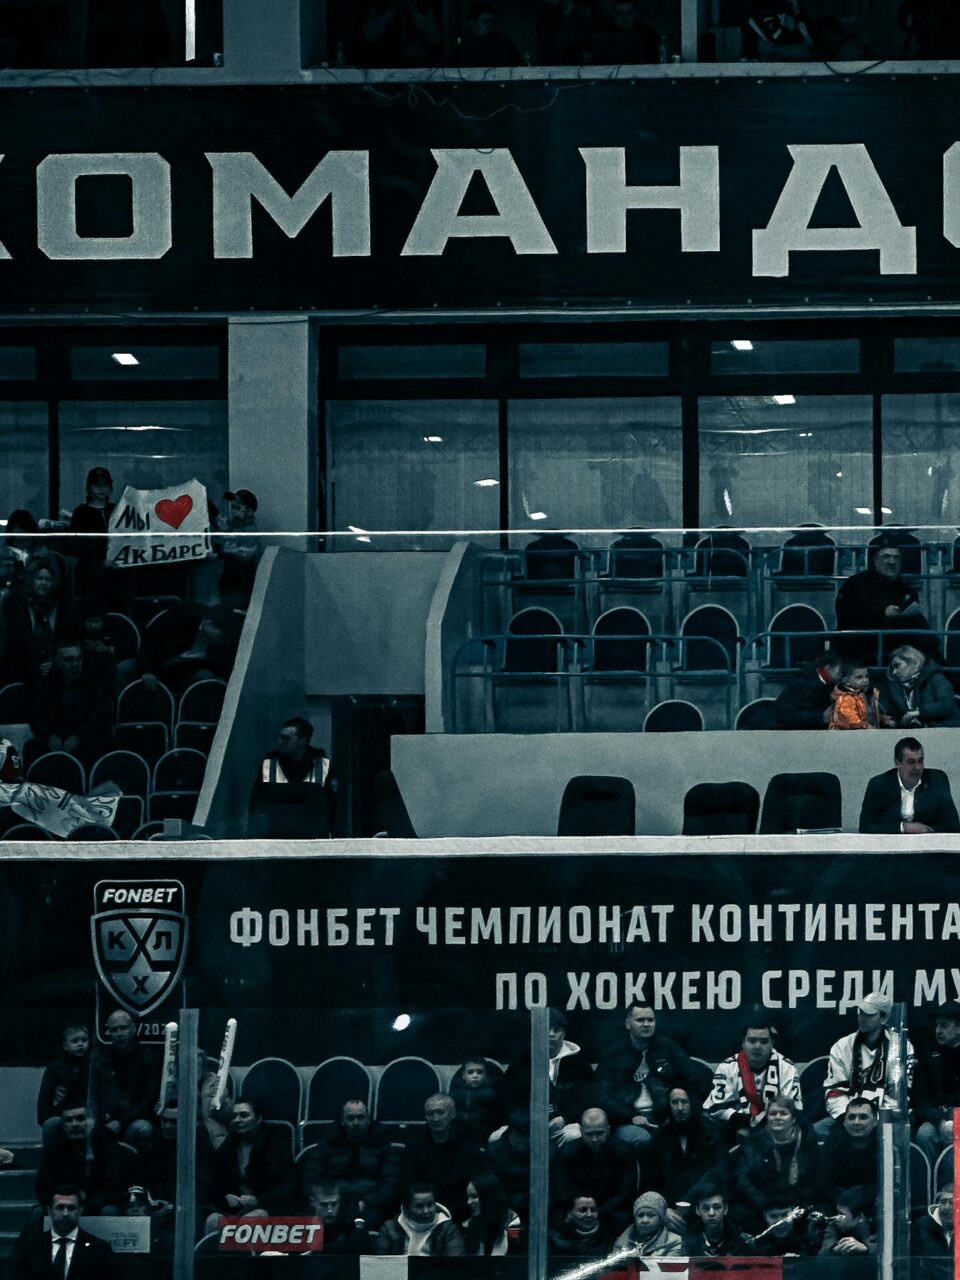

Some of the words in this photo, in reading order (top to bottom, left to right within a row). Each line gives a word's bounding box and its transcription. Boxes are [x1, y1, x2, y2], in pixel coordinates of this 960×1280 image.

[103, 888, 177, 903] FONBET
[229, 907, 400, 947] ФОНБЕТ
[416, 904, 674, 945] ЧЕМПИОНАТ
[495, 972, 548, 1010] ПО
[566, 970, 742, 1010] ХОККЕЮ
[220, 1225, 321, 1244] FONBET
